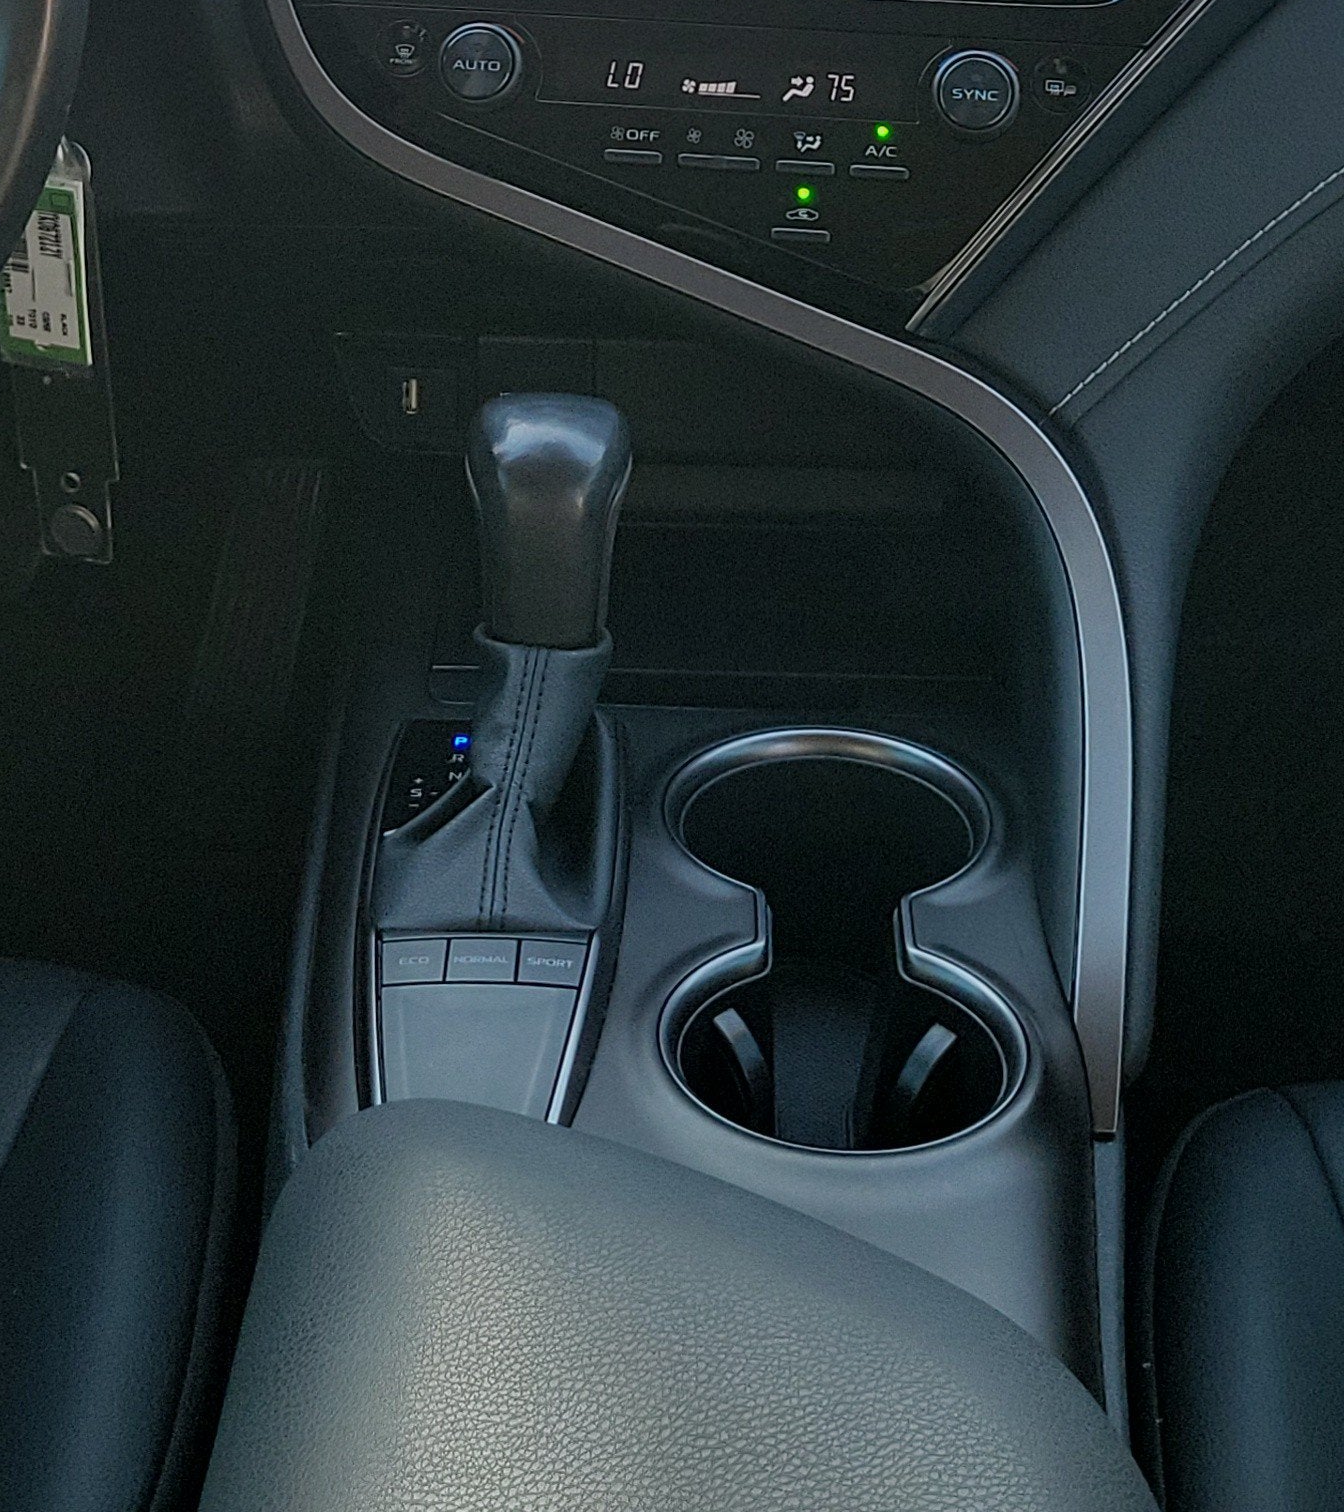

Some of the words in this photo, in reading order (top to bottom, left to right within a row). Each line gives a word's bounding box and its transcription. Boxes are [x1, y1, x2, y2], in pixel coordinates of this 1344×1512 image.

[452, 59, 501, 72] AUTO
[827, 74, 855, 102] 75
[952, 88, 999, 102] SYNC
[626, 129, 661, 143] OFF
[865, 145, 898, 157] A/C
[454, 736, 468, 746] P
[452, 753, 464, 763] R
[449, 771, 463, 781] N
[410, 788, 422, 797] S
[399, 956, 429, 966] ECO
[453, 955, 508, 964] NORMAL
[526, 957, 574, 969] SPORT
